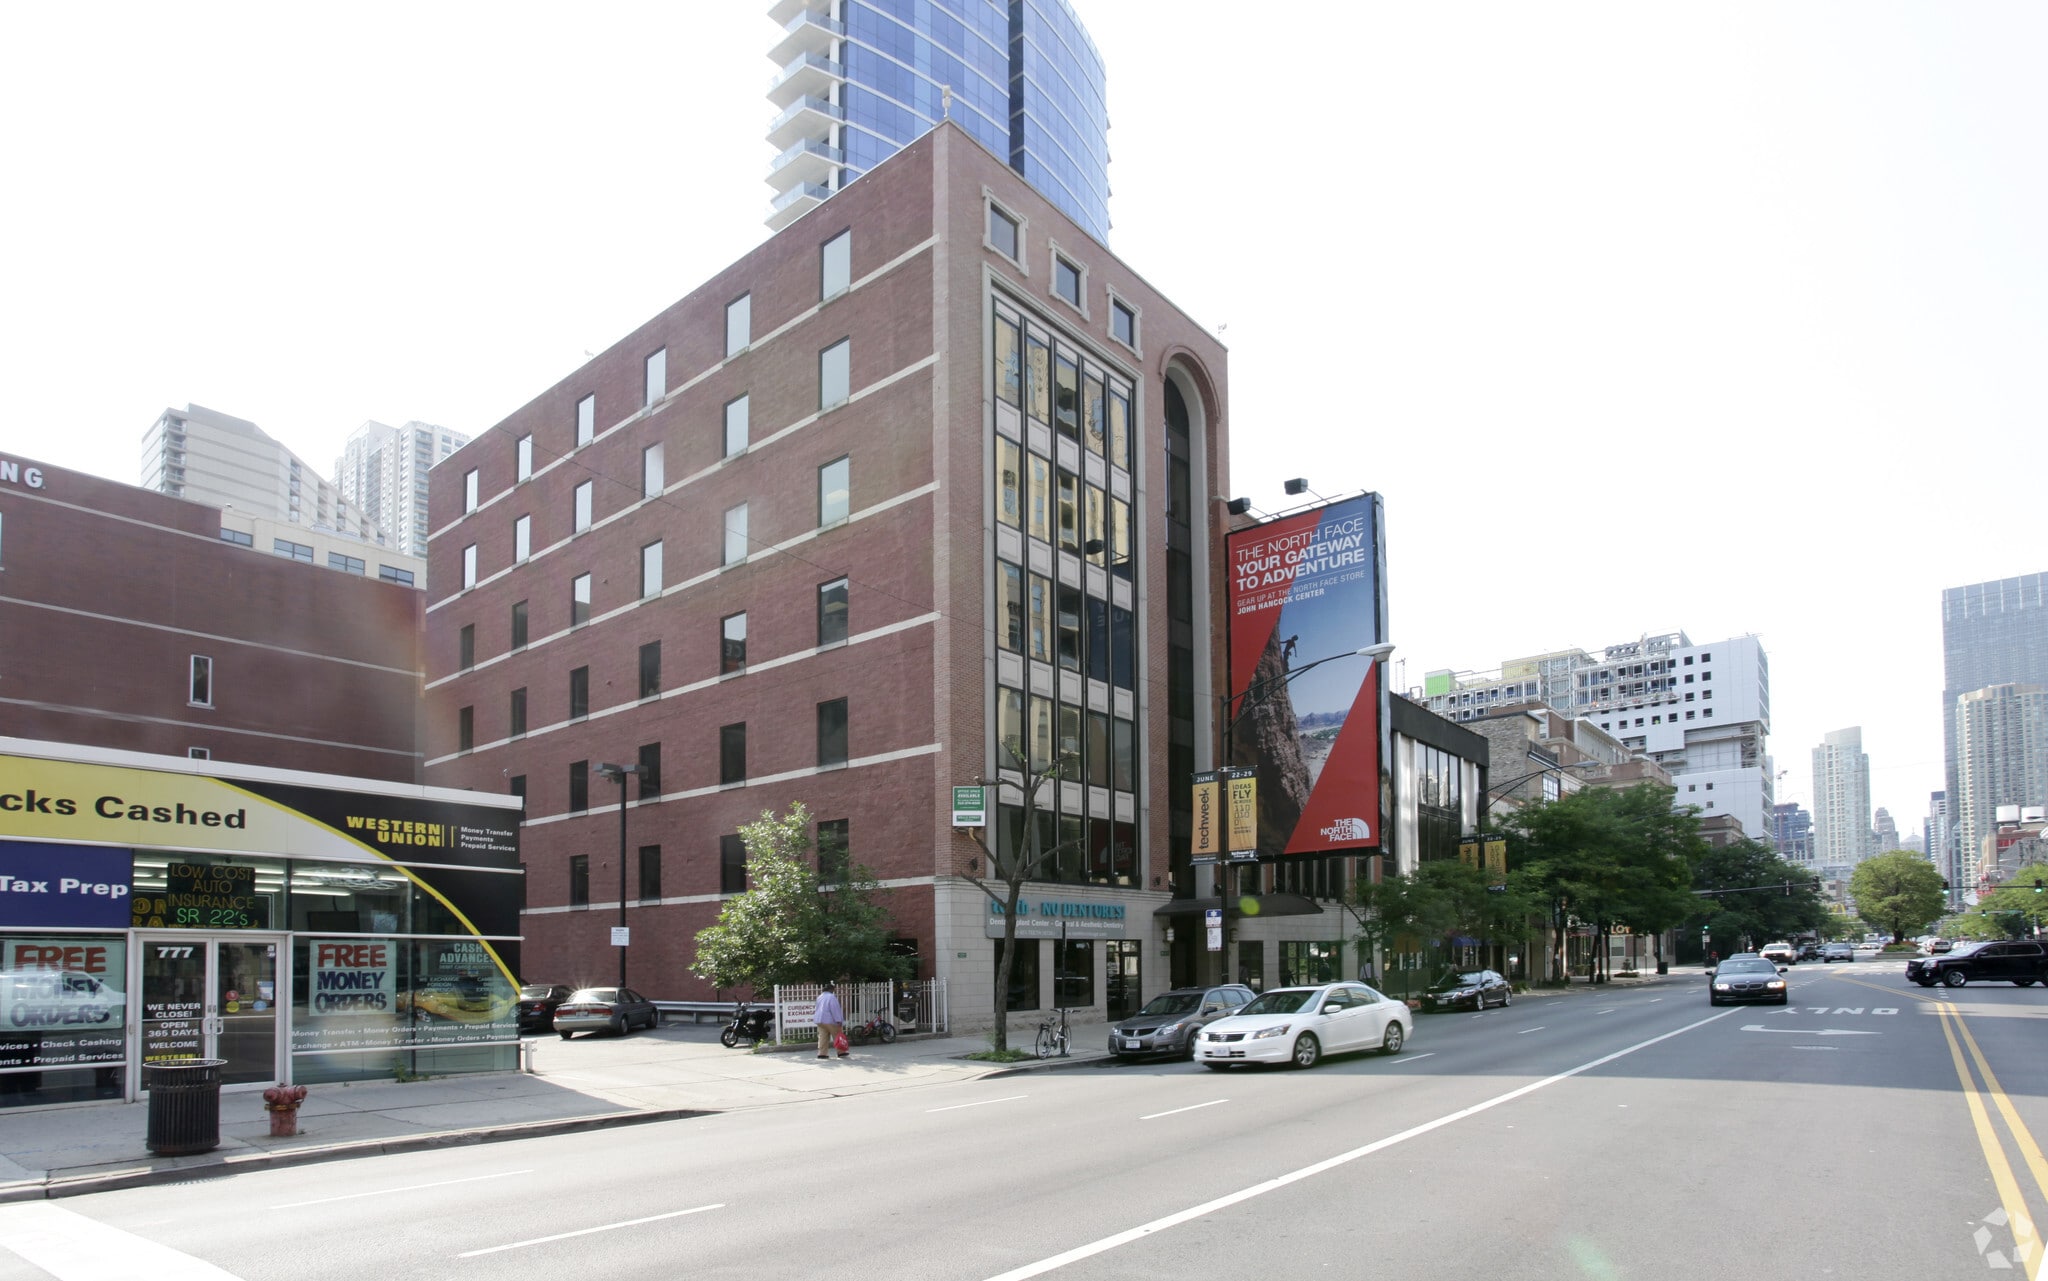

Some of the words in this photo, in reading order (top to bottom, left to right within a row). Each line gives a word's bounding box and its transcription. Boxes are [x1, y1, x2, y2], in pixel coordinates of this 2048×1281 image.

[1236, 544, 1264, 562] THE
[1268, 529, 1320, 554] NORTH
[1324, 517, 1363, 538] FACE
[1236, 554, 1280, 576] YOUR
[1285, 532, 1363, 565] GATEWAY
[1236, 575, 1259, 592] TO
[1262, 548, 1365, 586] ADVENTURE
[1237, 596, 1255, 608] GEAR
[1257, 594, 1266, 604] UP
[1267, 591, 1277, 601] AT
[1278, 587, 1291, 599] THE
[1293, 581, 1318, 594] NORTH
[1319, 577, 1338, 588] FACE
[1340, 570, 1365, 583] STORE
[1237, 604, 1256, 615] JOHN
[1258, 595, 1293, 610] HANCOCK
[1295, 588, 1325, 601] CENTER
[1196, 775, 1214, 783] JUNE
[1231, 771, 1253, 779] 22-29
[1233, 790, 1252, 799] FLY
[0, 789, 77, 816] cks
[95, 795, 246, 829] Cashed
[346, 816, 440, 835] WESTERN
[1199, 788, 1210, 850] techweek
[1333, 818, 1352, 827] THE
[460, 826, 484, 835] Money
[486, 828, 513, 837] Transfer
[1320, 825, 1352, 836] NORTH
[1329, 832, 1352, 841] FACE
[377, 831, 440, 847] UNION
[460, 834, 494, 843] Payments
[460, 841, 487, 851] Prepaid
[488, 843, 516, 852] Services
[172, 864, 207, 879] LOW
[212, 866, 252, 881] COST
[0, 875, 48, 893] Tax
[60, 878, 129, 899] Prep
[192, 879, 232, 894] AUTO
[168, 893, 255, 910] INSURANCE
[1041, 902, 1059, 916] NO
[177, 907, 200, 924] SR
[210, 909, 248, 926] 22's
[157, 947, 193, 959] 777
[453, 942, 483, 953] CASH
[14, 945, 107, 973] FREE
[317, 944, 387, 968] FREE
[317, 971, 385, 990] MONEY
[147, 1003, 165, 1011] WE
[315, 992, 387, 1013] ORDERS
[10, 1003, 110, 1027] ORDERS
[155, 1011, 192, 1019] CLOSE!
[1765, 1007, 1899, 1015] ONLY
[161, 1021, 188, 1029] OPEN
[292, 1030, 320, 1038] Money
[322, 1028, 356, 1037] Transfer
[363, 1027, 390, 1035] Money
[424, 1024, 458, 1032] Payments
[41, 1040, 76, 1049] Check
[79, 1038, 122, 1047] Cashing
[149, 1041, 198, 1049] WELCOME
[292, 1041, 332, 1050] Exchange
[33, 1054, 75, 1064] Prepaid
[78, 1052, 124, 1061] Services
